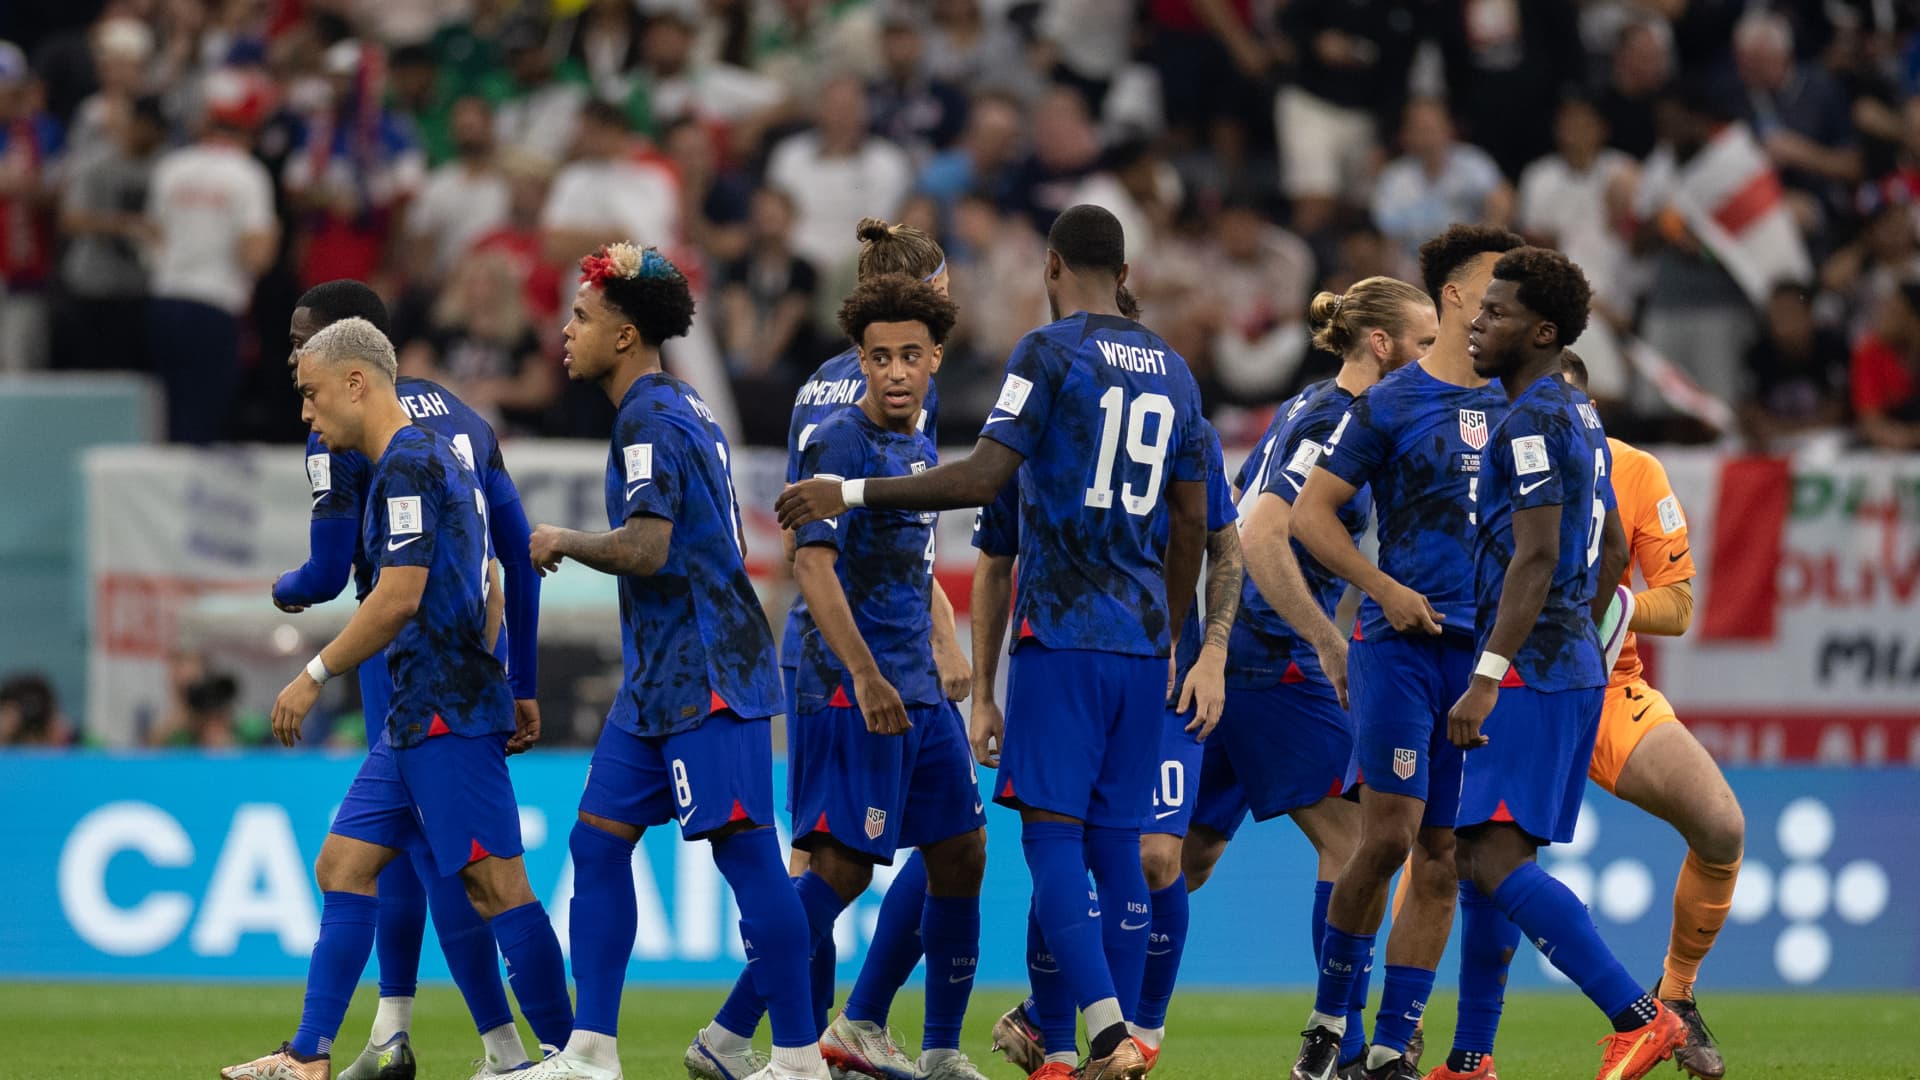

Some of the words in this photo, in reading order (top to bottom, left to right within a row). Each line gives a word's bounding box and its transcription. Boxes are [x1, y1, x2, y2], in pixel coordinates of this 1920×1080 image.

[1096, 340, 1167, 376] WRIGHT
[1461, 411, 1484, 428] USA
[1084, 386, 1175, 516] 19
[924, 527, 936, 575] 4
[1396, 749, 1415, 763] USA
[672, 759, 692, 808] 8
[868, 808, 885, 822] USA
[1088, 890, 1099, 901] US
[1127, 901, 1149, 914] USA
[1149, 932, 1170, 943] SA
[951, 957, 977, 967] USA
[1036, 951, 1056, 962] US
[1328, 958, 1352, 973] USA
[1411, 1000, 1426, 1013] US
